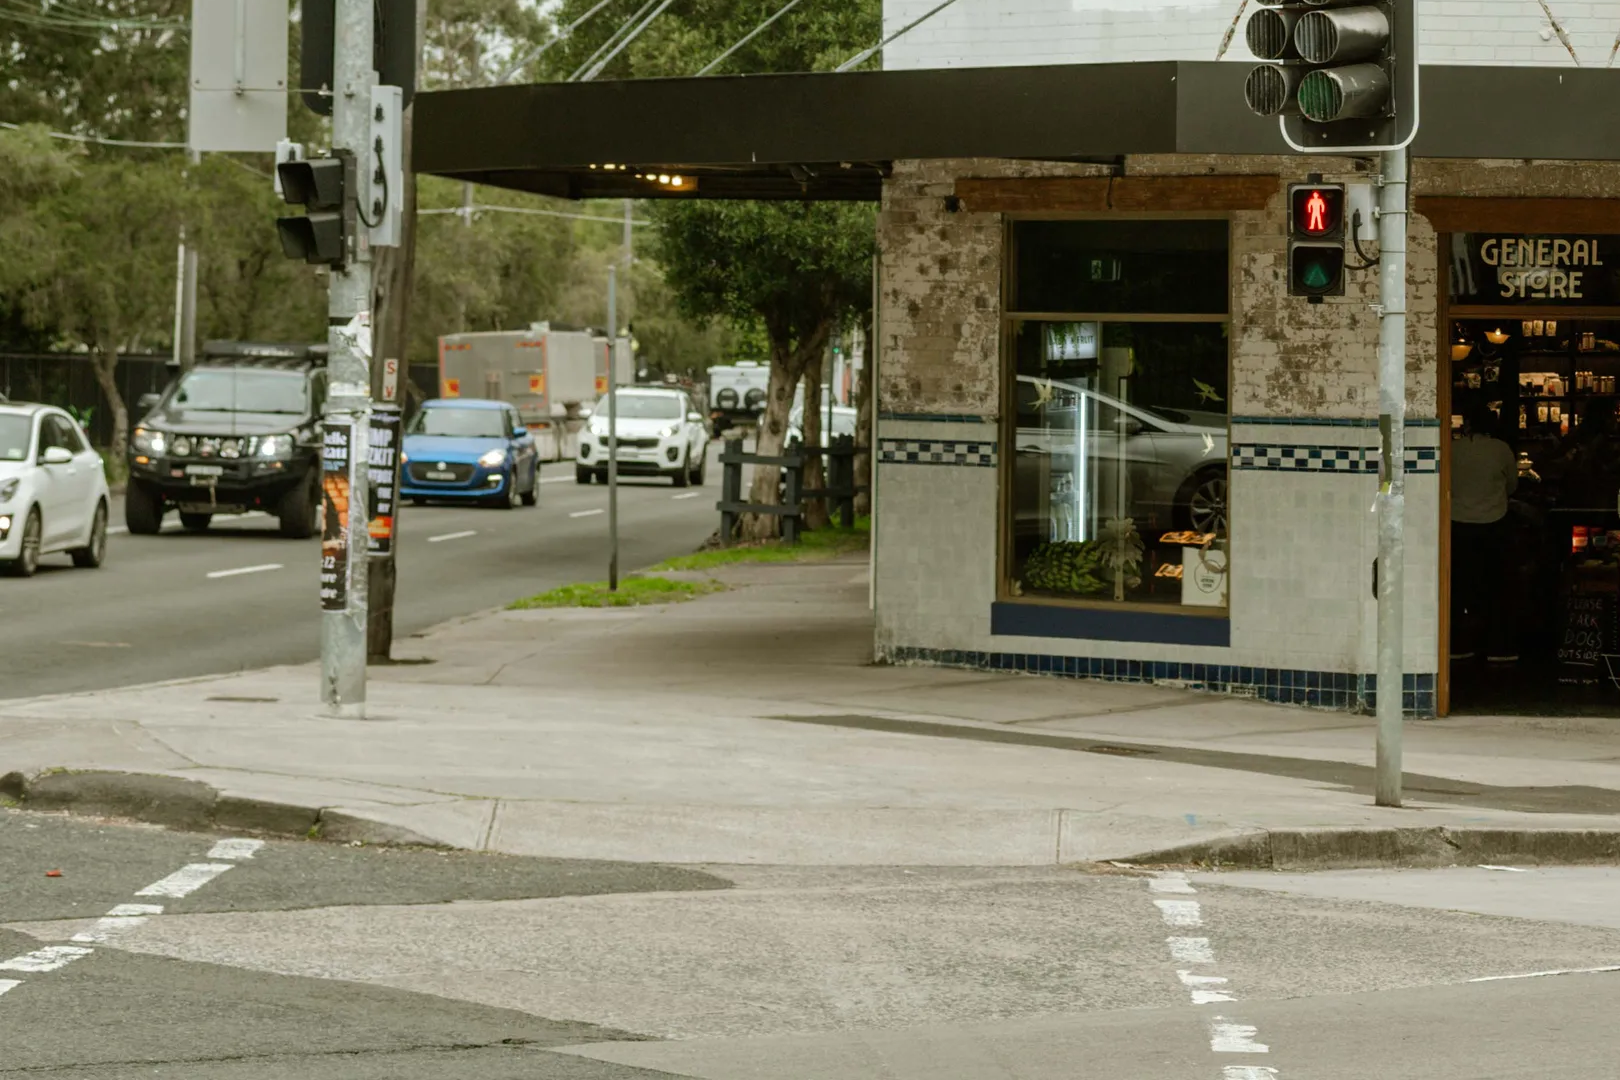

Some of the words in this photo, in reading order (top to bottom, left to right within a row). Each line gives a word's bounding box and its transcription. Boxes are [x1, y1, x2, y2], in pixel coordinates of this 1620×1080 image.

[1481, 239, 1603, 266] GENERAL
[1501, 272, 1583, 298] STORE
[387, 361, 396, 374] S
[1567, 599, 1602, 609] PLEASE
[1564, 629, 1602, 649] DOGS
